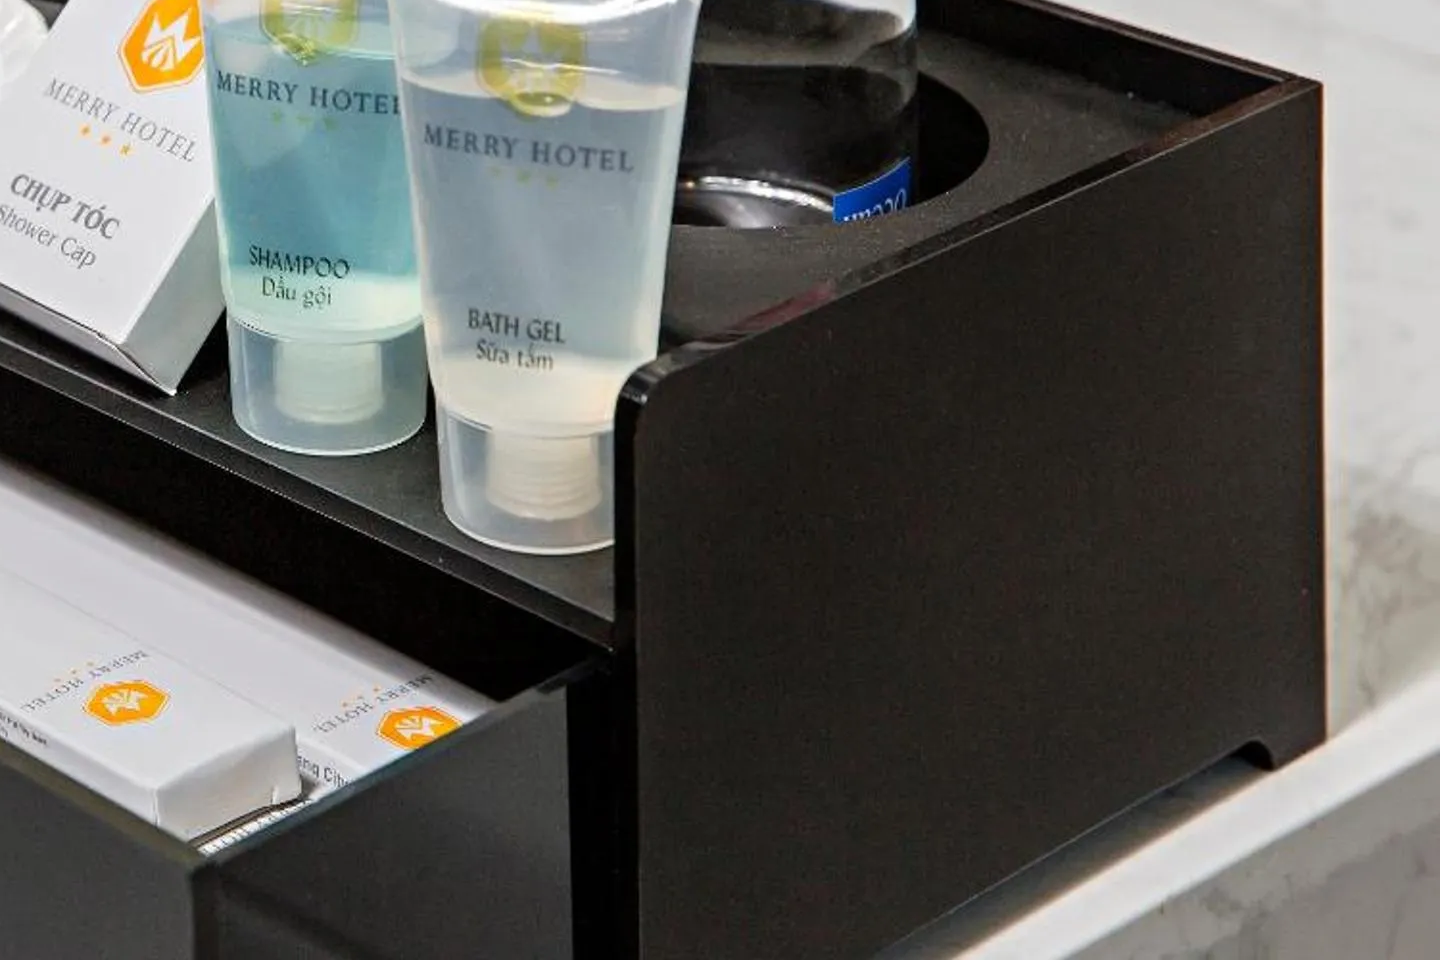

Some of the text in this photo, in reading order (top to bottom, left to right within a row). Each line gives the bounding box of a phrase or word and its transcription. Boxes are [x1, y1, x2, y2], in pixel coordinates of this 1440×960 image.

[216, 69, 300, 105] MERRY
[45, 76, 198, 163] MERRY HOTEL
[423, 123, 635, 174] MERRY HOTEL
[10, 173, 121, 240] CHỤP TÓC
[60, 236, 98, 271] Cap
[248, 245, 351, 280] SHAMPOO
[467, 308, 566, 344] BATH GEL
